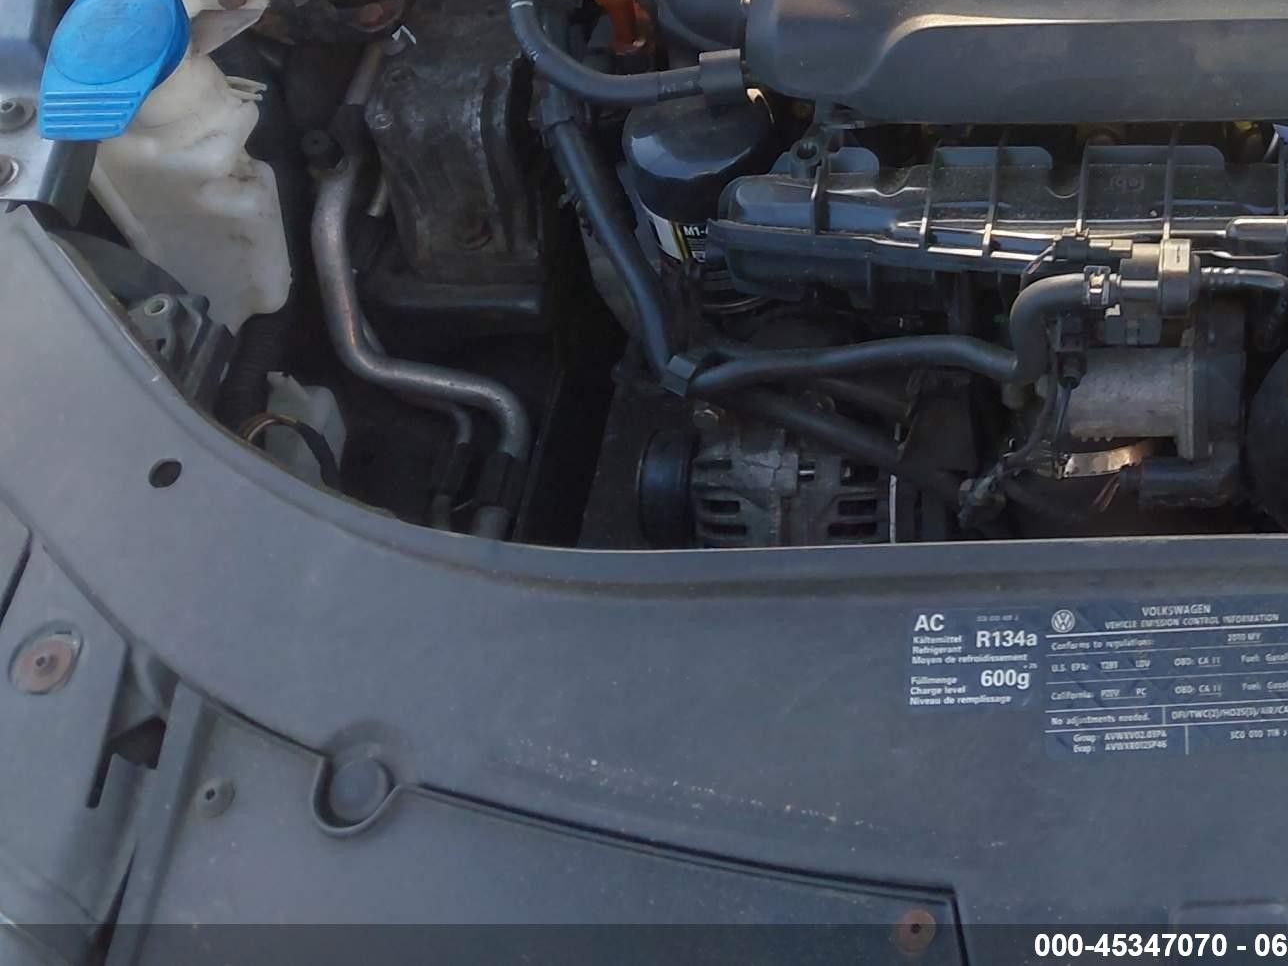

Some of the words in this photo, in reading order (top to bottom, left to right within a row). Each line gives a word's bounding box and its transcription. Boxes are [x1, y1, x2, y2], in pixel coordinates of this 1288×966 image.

[1141, 604, 1211, 616] VOLKSWAGEN
[914, 614, 945, 632] AC
[1105, 620, 1137, 629] VEHICLE
[1140, 618, 1180, 628] EMISSION
[1182, 616, 1219, 626] CONTROL
[1222, 614, 1280, 624] INFORMATION
[976, 630, 1038, 648] R134a
[912, 646, 962, 656] Refrigerant
[1051, 641, 1090, 650] Conforms
[912, 657, 942, 666] Moyen
[981, 669, 1030, 690] 600g
[910, 687, 942, 696] Charge
[944, 685, 966, 694] level
[909, 697, 941, 705] Niveau
[943, 696, 955, 704] de
[1051, 717, 1063, 725] No
[1066, 715, 1116, 726] adjustments
